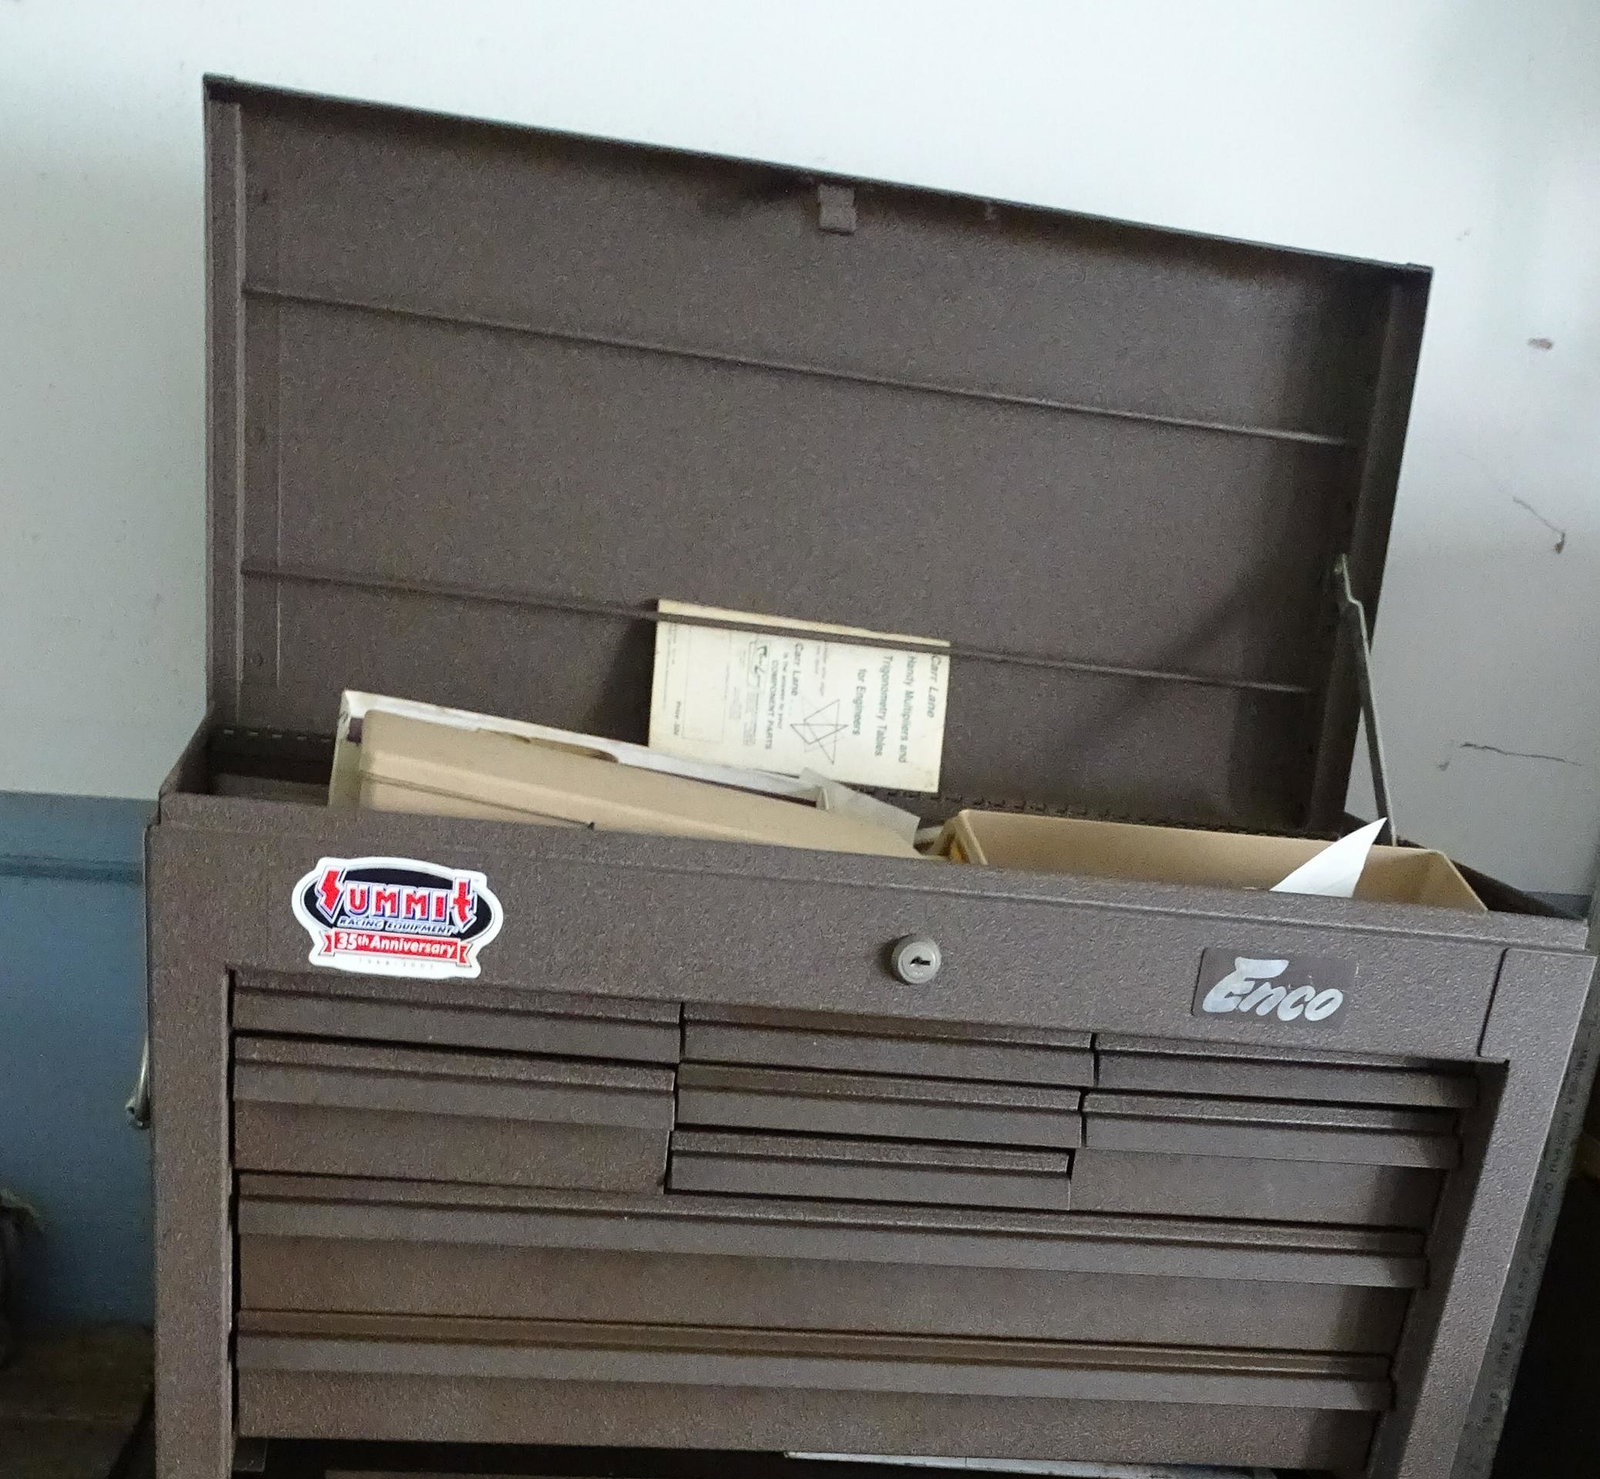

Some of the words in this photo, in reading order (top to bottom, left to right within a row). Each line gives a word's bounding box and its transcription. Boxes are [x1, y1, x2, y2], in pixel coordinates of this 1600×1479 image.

[794, 642, 804, 666] Carr
[930, 654, 942, 683] Carr
[791, 670, 801, 696] Lane
[857, 668, 867, 682] for
[903, 655, 917, 685] Handy
[768, 660, 779, 717] COMPONENT
[876, 655, 893, 720] Trigonometry
[927, 686, 939, 718] Lane
[852, 686, 866, 735] Engineers
[901, 690, 914, 741] Multipliers
[874, 725, 887, 756] Tables
[898, 744, 908, 763] and
[338, 917, 383, 930] RACING
[386, 920, 454, 936] EQUIPMENT
[338, 932, 369, 950] 35th
[370, 936, 456, 959] Anniversary
[1202, 956, 1344, 1022] Enco
